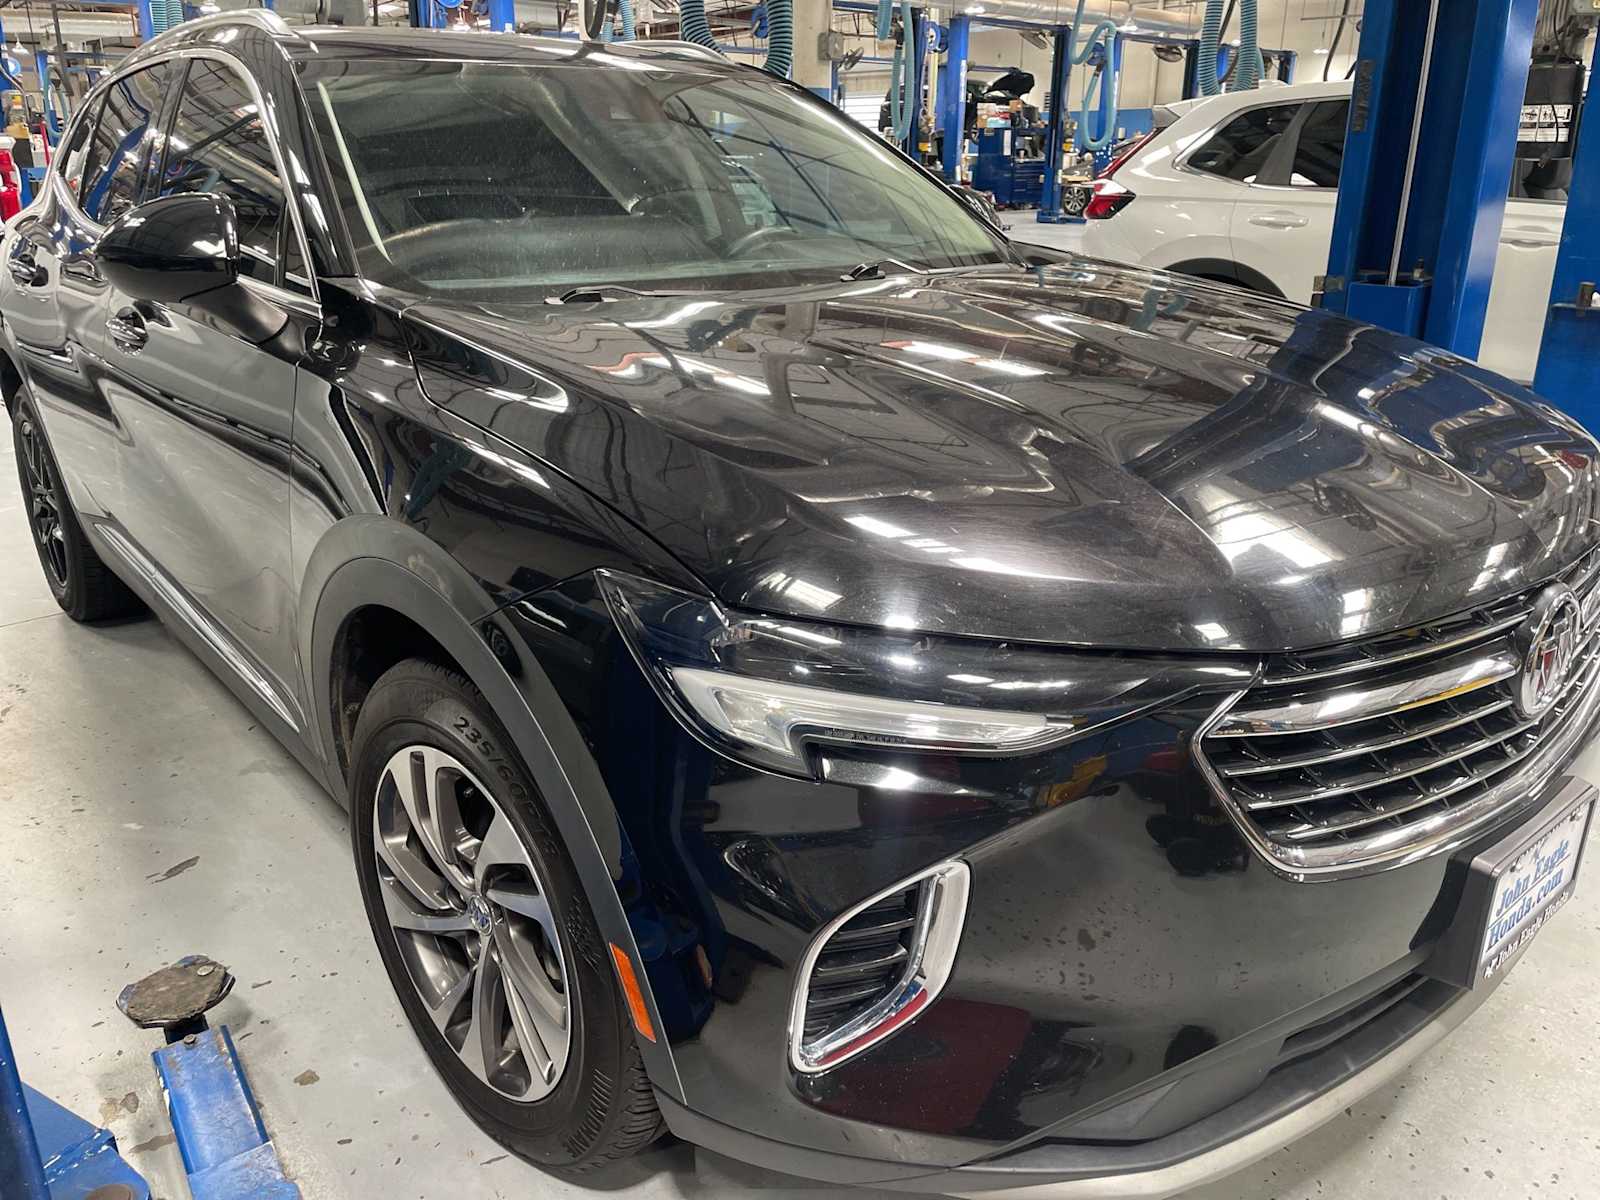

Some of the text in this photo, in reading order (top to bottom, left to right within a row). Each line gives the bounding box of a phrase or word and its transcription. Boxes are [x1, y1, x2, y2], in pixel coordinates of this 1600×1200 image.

[1488, 867, 1564, 949] Honda.com
[1496, 840, 1569, 917] John Eagle
[1495, 942, 1519, 971] John
[1520, 917, 1543, 944] Eagle
